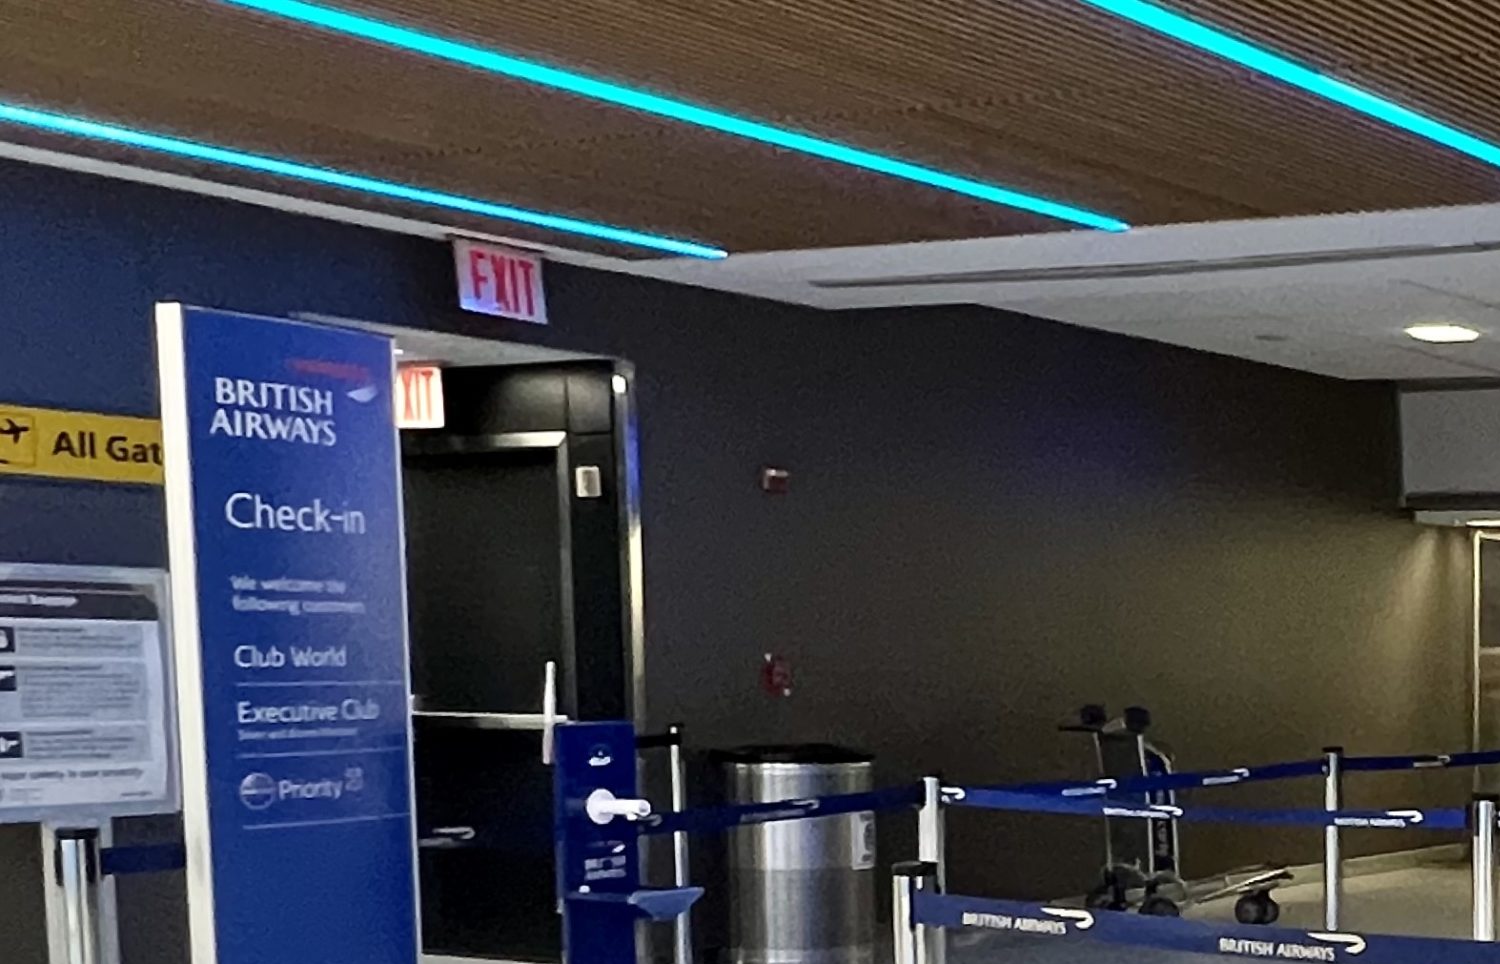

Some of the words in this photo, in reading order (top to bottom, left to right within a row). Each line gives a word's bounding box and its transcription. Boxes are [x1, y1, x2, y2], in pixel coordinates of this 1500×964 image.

[470, 248, 536, 316] EXIT
[214, 377, 334, 416] BRITISH
[400, 369, 435, 421] XIT
[209, 408, 338, 446] AIRWAYS
[52, 430, 97, 459] All
[105, 435, 163, 466] Gat
[225, 492, 366, 534] Check-in
[234, 645, 285, 668] Club
[289, 645, 347, 668] World
[237, 701, 339, 724] Executive
[341, 698, 381, 721] Club
[278, 779, 344, 800] Priority
[1219, 937, 1274, 956] BRITISH
[1276, 942, 1336, 962] AIRWAYS
